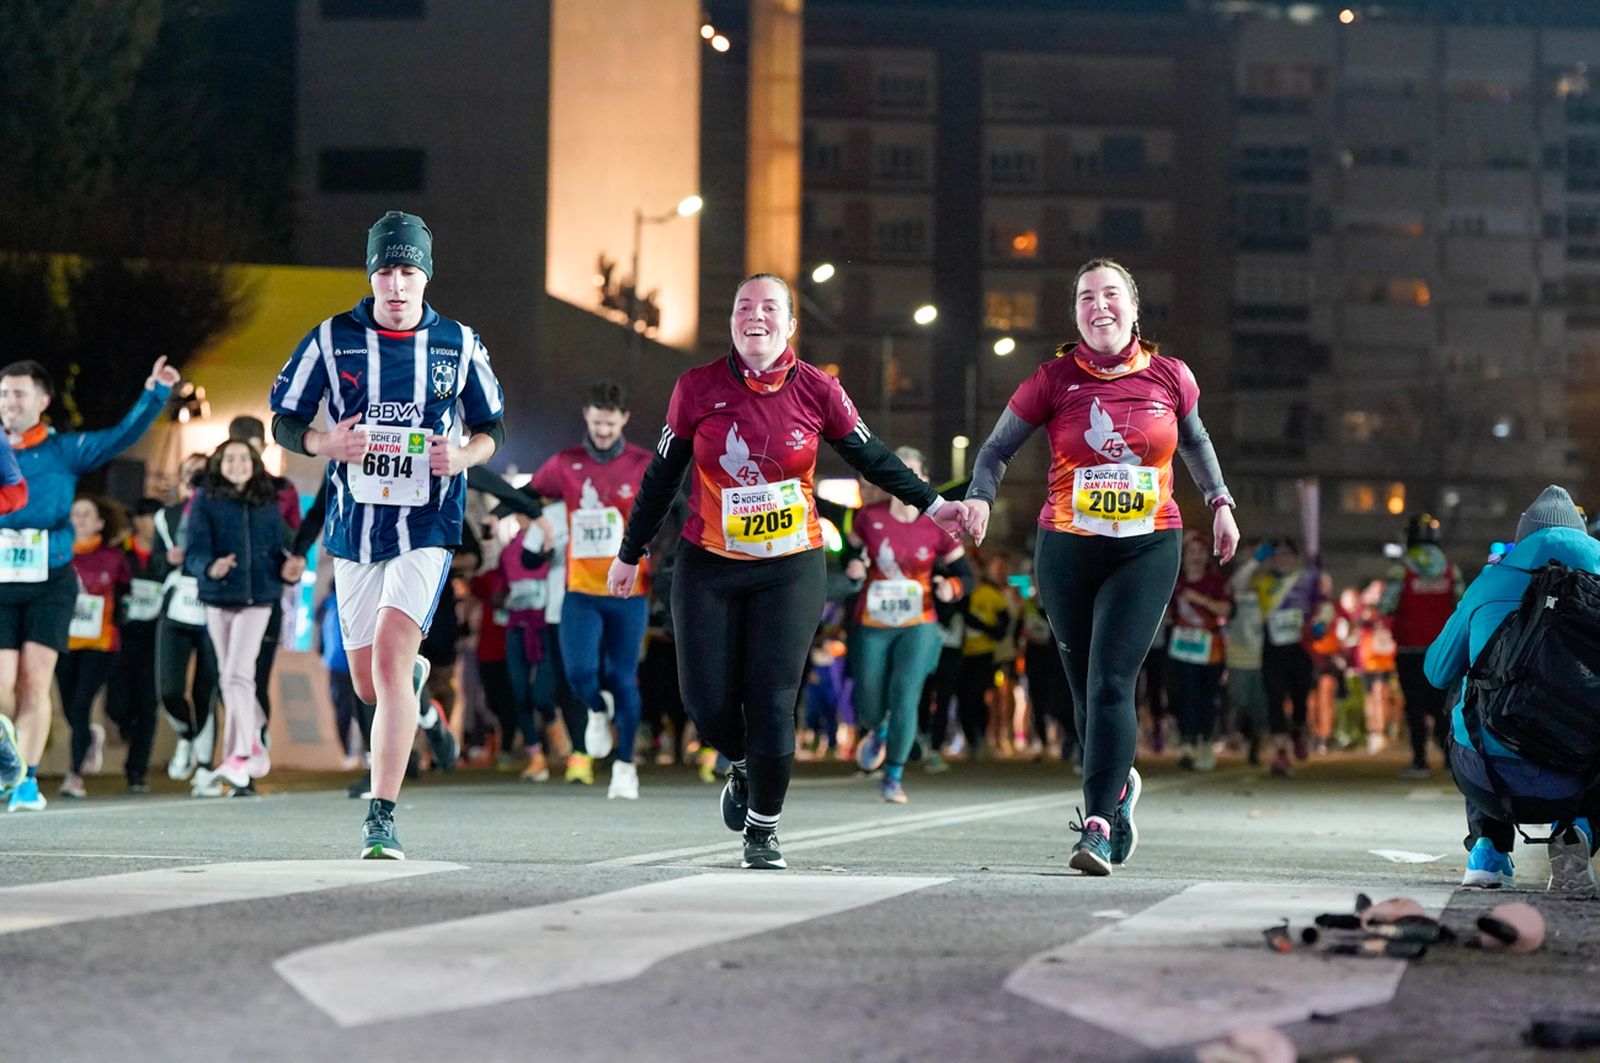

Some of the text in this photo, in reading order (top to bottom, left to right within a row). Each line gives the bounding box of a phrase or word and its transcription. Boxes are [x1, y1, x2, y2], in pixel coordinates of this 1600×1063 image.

[386, 244, 417, 252] MADE
[385, 251, 422, 264] FRANCE
[368, 404, 421, 419] BBVA
[370, 433, 391, 443] OCHE
[1101, 438, 1125, 458] 43
[363, 453, 413, 478] 6814
[736, 466, 759, 486] 43
[1094, 471, 1118, 480] NOCHE
[1120, 472, 1129, 480] DE
[1084, 481, 1100, 490] SAN
[741, 494, 766, 504] NOCHE
[1089, 490, 1144, 514] 2094
[732, 505, 749, 515] SAN
[741, 508, 793, 537] 7205
